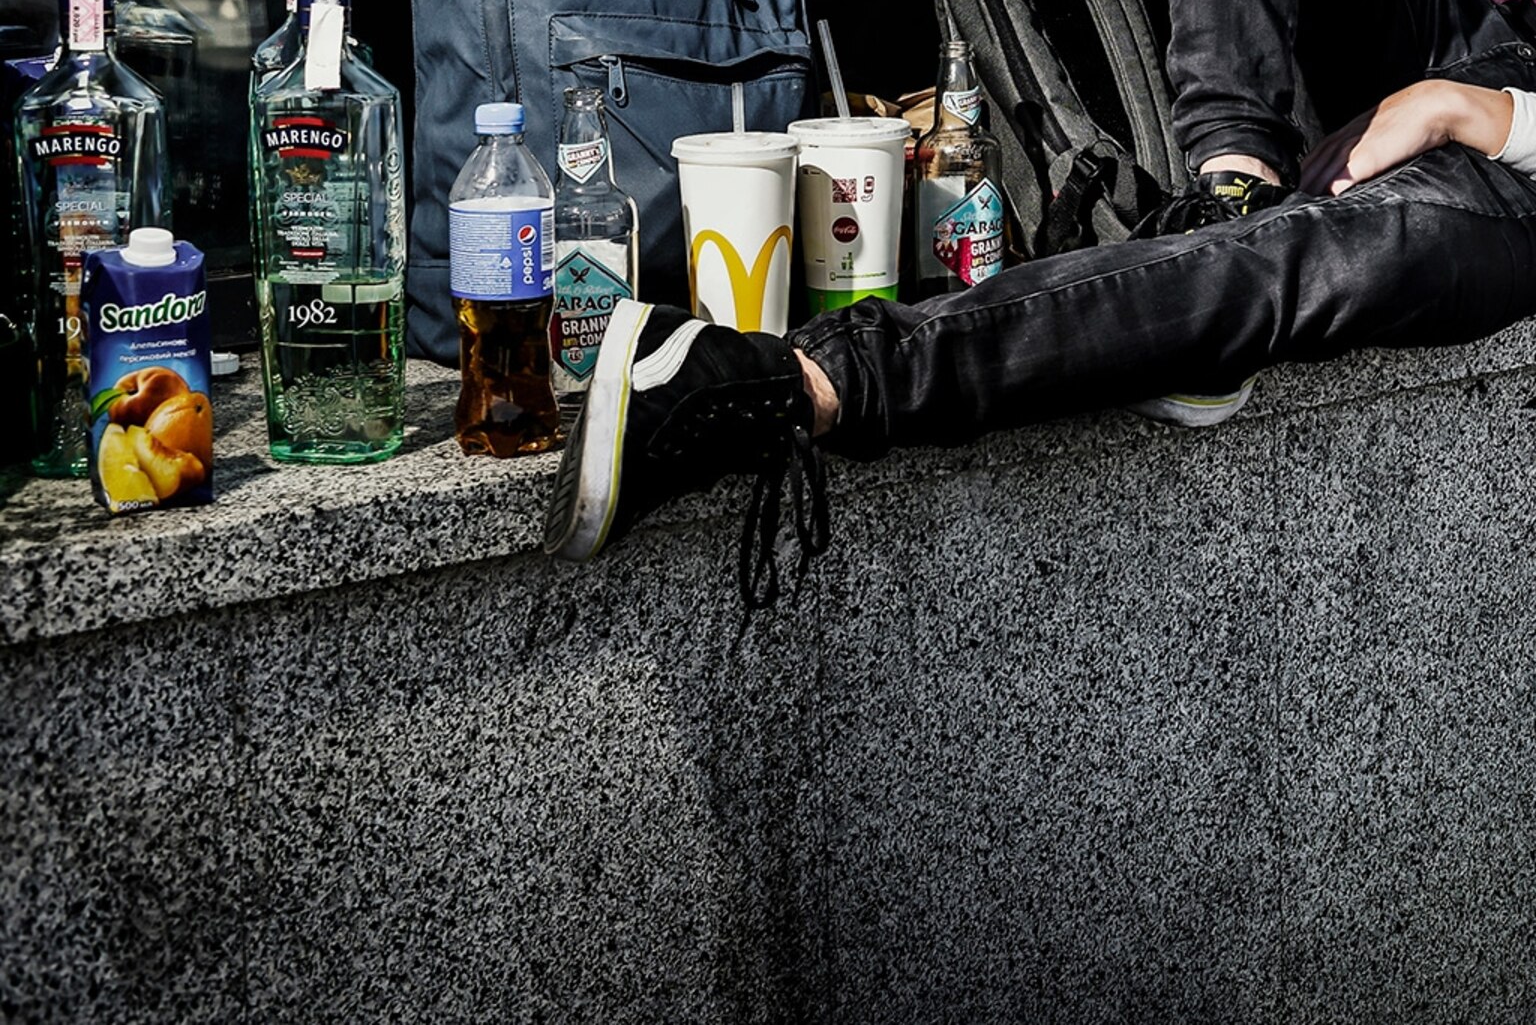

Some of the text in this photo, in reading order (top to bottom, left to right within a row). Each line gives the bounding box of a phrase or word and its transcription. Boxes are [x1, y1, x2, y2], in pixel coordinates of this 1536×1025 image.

[35, 137, 121, 156] MARENGO
[266, 129, 343, 148] MARENGO
[282, 191, 330, 204] SPECIAL
[1214, 184, 1245, 198] PUMA
[55, 200, 105, 213] SPECIAL
[954, 218, 1004, 236] GARAG
[971, 236, 1002, 256] GRANN
[521, 246, 535, 285] pepsi
[100, 290, 207, 333] Sandora
[556, 293, 623, 312] ARAG
[287, 298, 338, 328] 1982
[57, 316, 82, 340] 19
[561, 315, 612, 336] GRANN
[580, 332, 604, 347] COM
